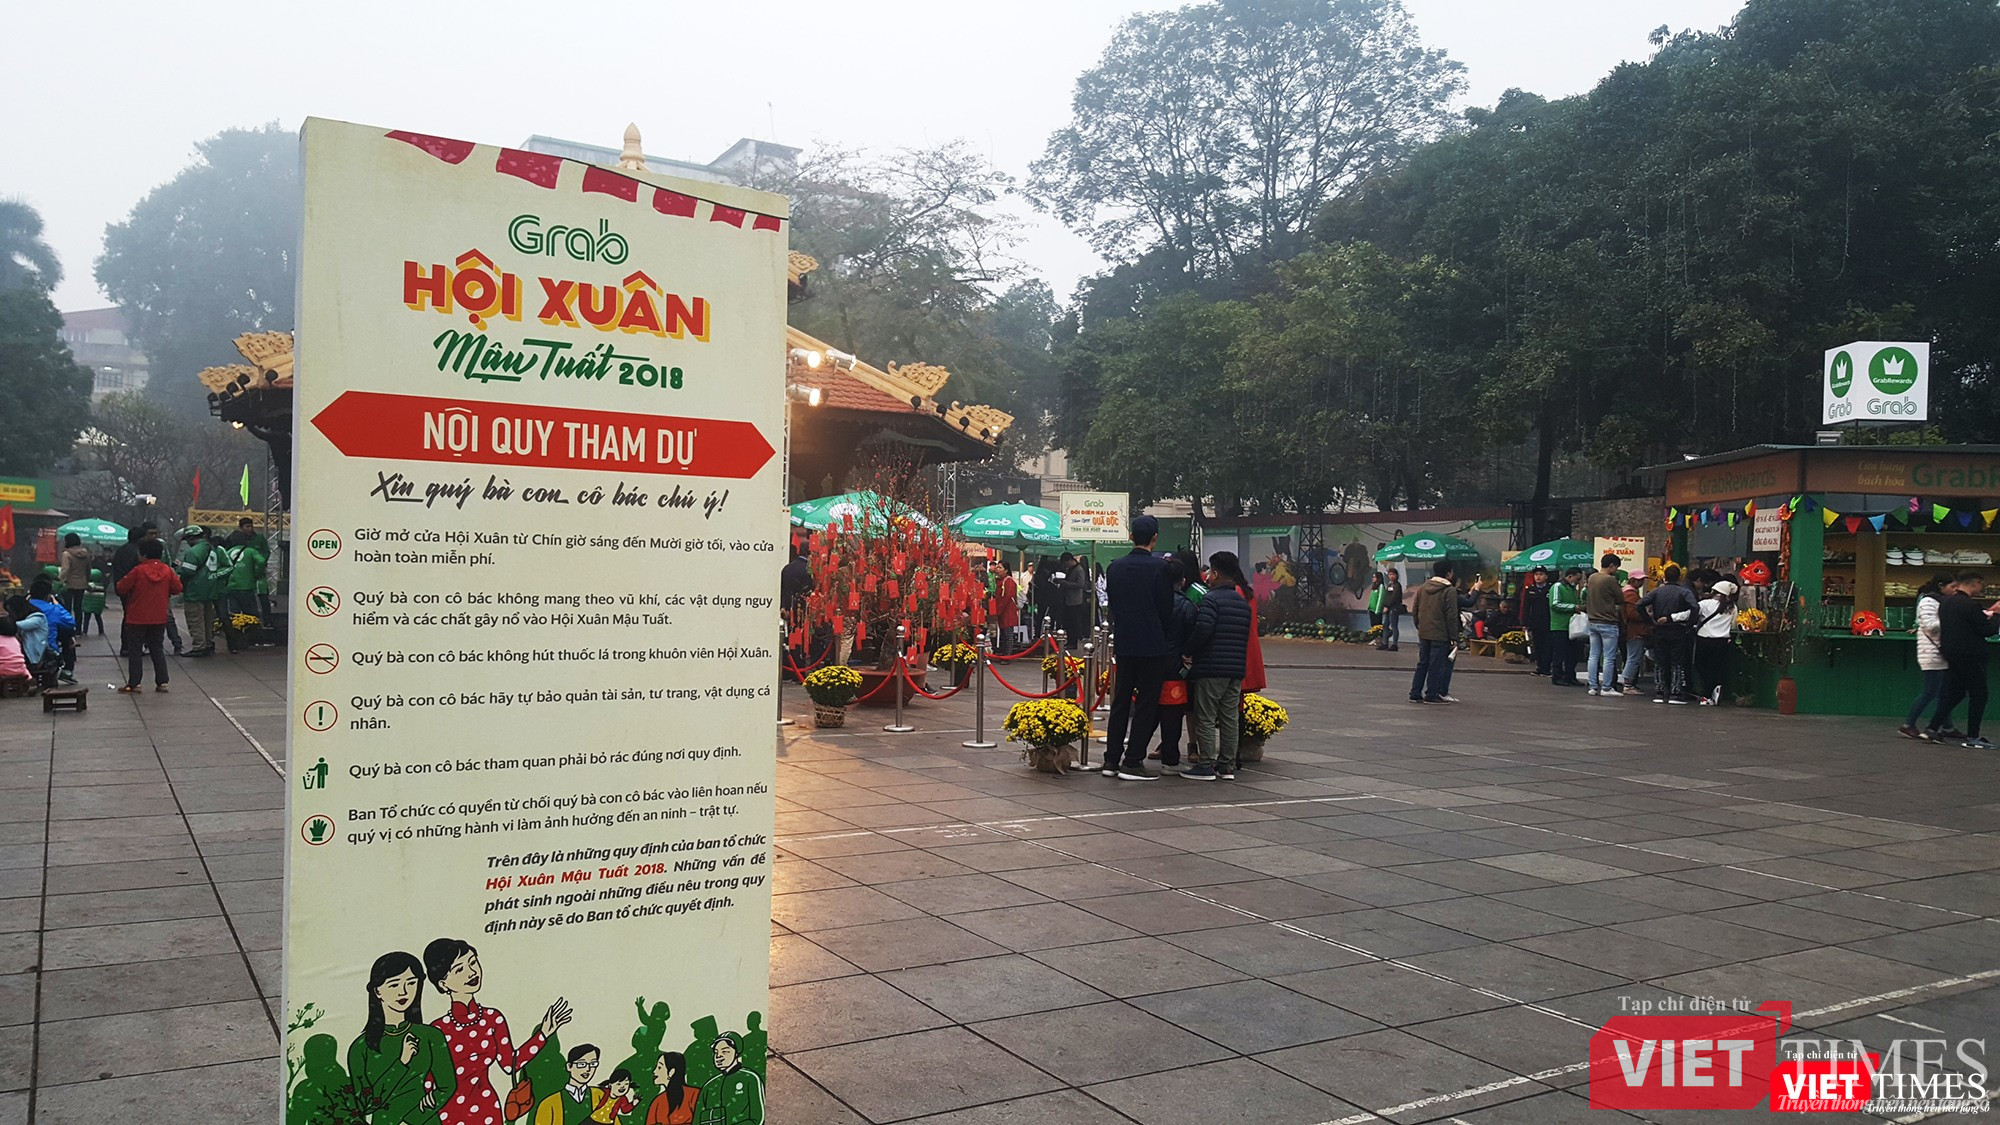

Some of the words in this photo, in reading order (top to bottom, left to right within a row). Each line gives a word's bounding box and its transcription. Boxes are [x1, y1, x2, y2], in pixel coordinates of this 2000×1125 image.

[508, 214, 630, 265] Grab
[403, 248, 522, 331] HỘI
[538, 270, 711, 343] XUÂN
[433, 329, 537, 383] Mậu
[523, 338, 650, 382] Tuất
[619, 364, 684, 390] 2018
[1828, 398, 1852, 419] Grab
[1867, 396, 1918, 415] Grab
[423, 406, 479, 457] NỘI
[492, 417, 555, 456] QUY
[563, 422, 646, 464] THAM
[656, 428, 698, 470] DỰ
[371, 470, 424, 503] Xin
[425, 476, 475, 510] quý
[482, 474, 514, 501] bà
[522, 485, 569, 505] con
[577, 483, 606, 505] cô
[612, 480, 648, 508] bác
[657, 485, 697, 510] chú
[702, 488, 730, 519] ý!
[1700, 469, 1776, 495] GrabRewards
[1084, 499, 1104, 507] Grab
[974, 518, 1011, 526] Grab
[311, 539, 338, 549] OPEN
[355, 528, 381, 540] Giờ
[386, 529, 410, 541] mở
[414, 529, 440, 542] cửa
[446, 531, 469, 546] Hội
[474, 532, 508, 544] Xuân
[513, 533, 528, 544] từ
[532, 534, 562, 545] Chín
[566, 535, 586, 548] giờ
[590, 535, 619, 550] sáng
[623, 536, 646, 548] đến
[650, 538, 681, 549] Mười
[685, 538, 704, 552] giờ
[707, 538, 725, 551] tối,
[730, 540, 750, 551] vào
[754, 540, 774, 551] cửa
[354, 550, 390, 562] hoàn
[395, 551, 427, 563] toàn
[432, 550, 466, 564] miễn
[470, 553, 495, 567] phí.
[354, 591, 384, 606] Quý
[390, 591, 407, 603] bà
[414, 595, 439, 603] con
[445, 592, 462, 604] cô
[468, 592, 492, 604] bác
[498, 592, 540, 607] không
[544, 596, 580, 607] mang
[585, 594, 614, 604] theo
[619, 594, 634, 604] vũ
[639, 594, 660, 606] khí,
[665, 594, 685, 605] các
[690, 594, 708, 608] vật
[712, 595, 741, 608] dụng
[746, 598, 772, 608] nguy
[353, 611, 388, 625] hiểm
[393, 613, 409, 625] và
[414, 613, 437, 625] các
[441, 612, 471, 625] chất
[474, 613, 498, 628] gây
[502, 612, 520, 625] nổ
[523, 613, 547, 624] vào
[551, 613, 573, 627] Hội
[577, 613, 609, 624] Xuân
[613, 614, 639, 627] Mậu
[642, 612, 672, 624] Tuất.
[349, 763, 380, 779] Quý
[384, 762, 401, 775] bà
[405, 764, 431, 774] con
[435, 760, 452, 772] cô
[456, 759, 480, 771] bác
[484, 758, 518, 770] tham
[522, 758, 555, 770] quan
[559, 753, 586, 768] phải
[590, 752, 607, 764] bỏ
[610, 751, 629, 763] rác
[632, 750, 663, 763] đúng
[666, 748, 685, 760] nơi
[688, 750, 710, 761] quy
[713, 746, 741, 760] định.
[487, 855, 519, 868] Trên
[522, 852, 549, 866] đây
[551, 850, 564, 862] là
[566, 848, 611, 861] những
[613, 846, 638, 859] quy
[640, 842, 669, 856] định
[671, 839, 694, 852] của
[696, 839, 720, 850] ban
[723, 834, 737, 847] tổ
[738, 834, 766, 846] chức
[486, 876, 512, 891] Hội
[517, 873, 554, 887] Xuân
[561, 870, 592, 884] Mậu
[599, 864, 629, 879] Tuất
[634, 863, 667, 876] 2018.
[674, 859, 716, 872] Những
[723, 854, 745, 867] vấn
[750, 852, 766, 865] đề
[484, 897, 520, 914] phát
[523, 894, 552, 908] sinh
[556, 889, 596, 906] ngoài
[599, 886, 642, 900] những
[646, 881, 674, 895] điều
[677, 880, 701, 892] nêu
[705, 878, 739, 889] trong
[742, 875, 765, 888] quy
